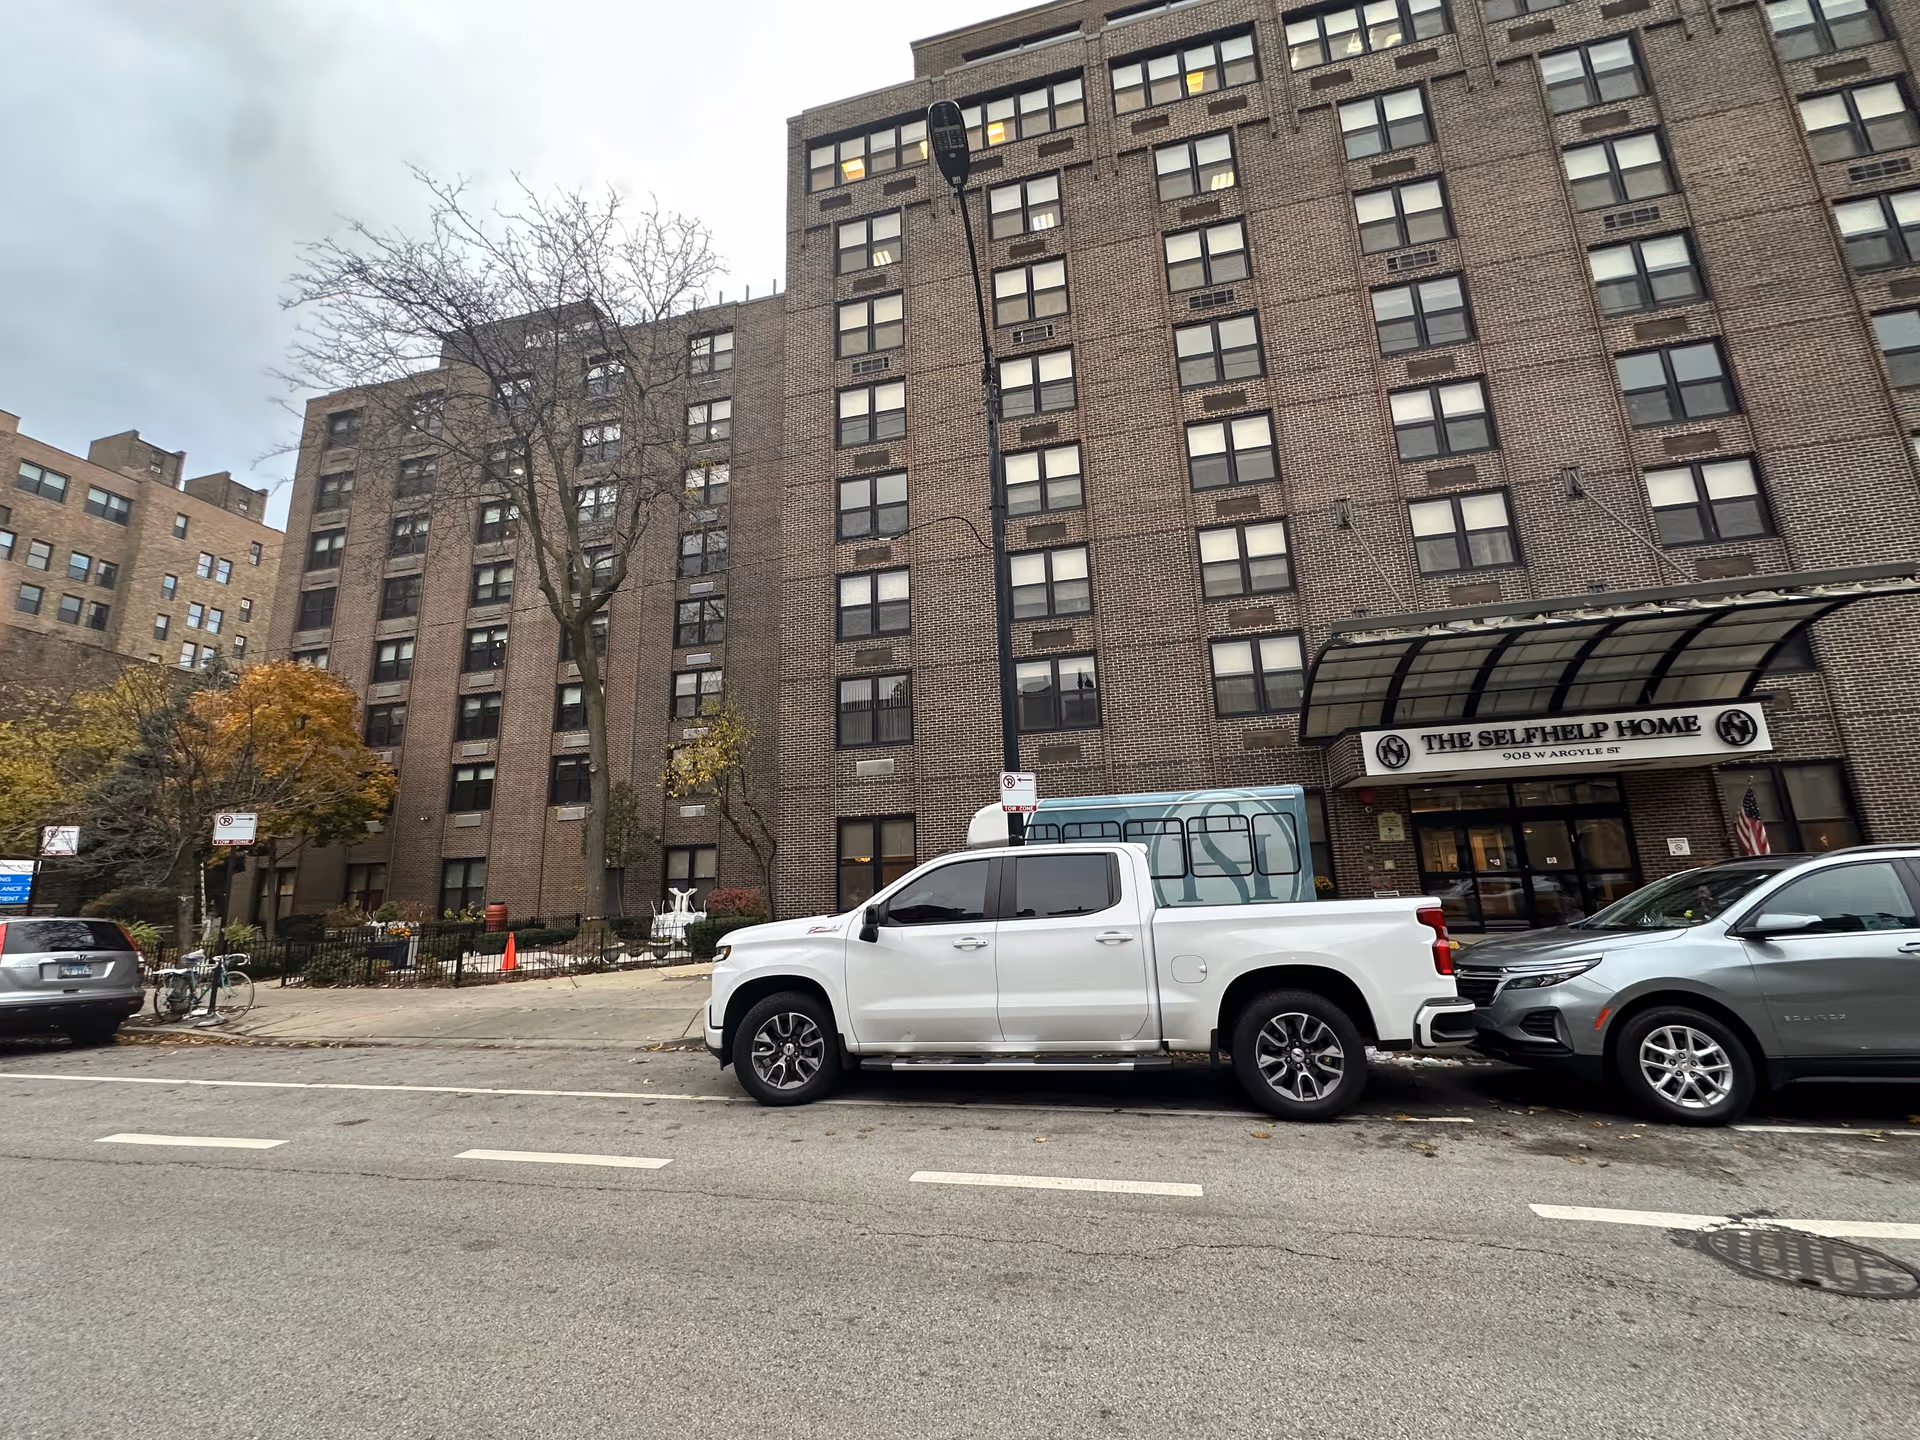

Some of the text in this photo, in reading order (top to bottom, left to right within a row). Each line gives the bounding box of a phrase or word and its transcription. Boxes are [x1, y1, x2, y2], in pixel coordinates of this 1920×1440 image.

[1421, 714, 1702, 751] THE SELFHELP HOME
[1502, 746, 1622, 761] 908 W ARGYLE ST
